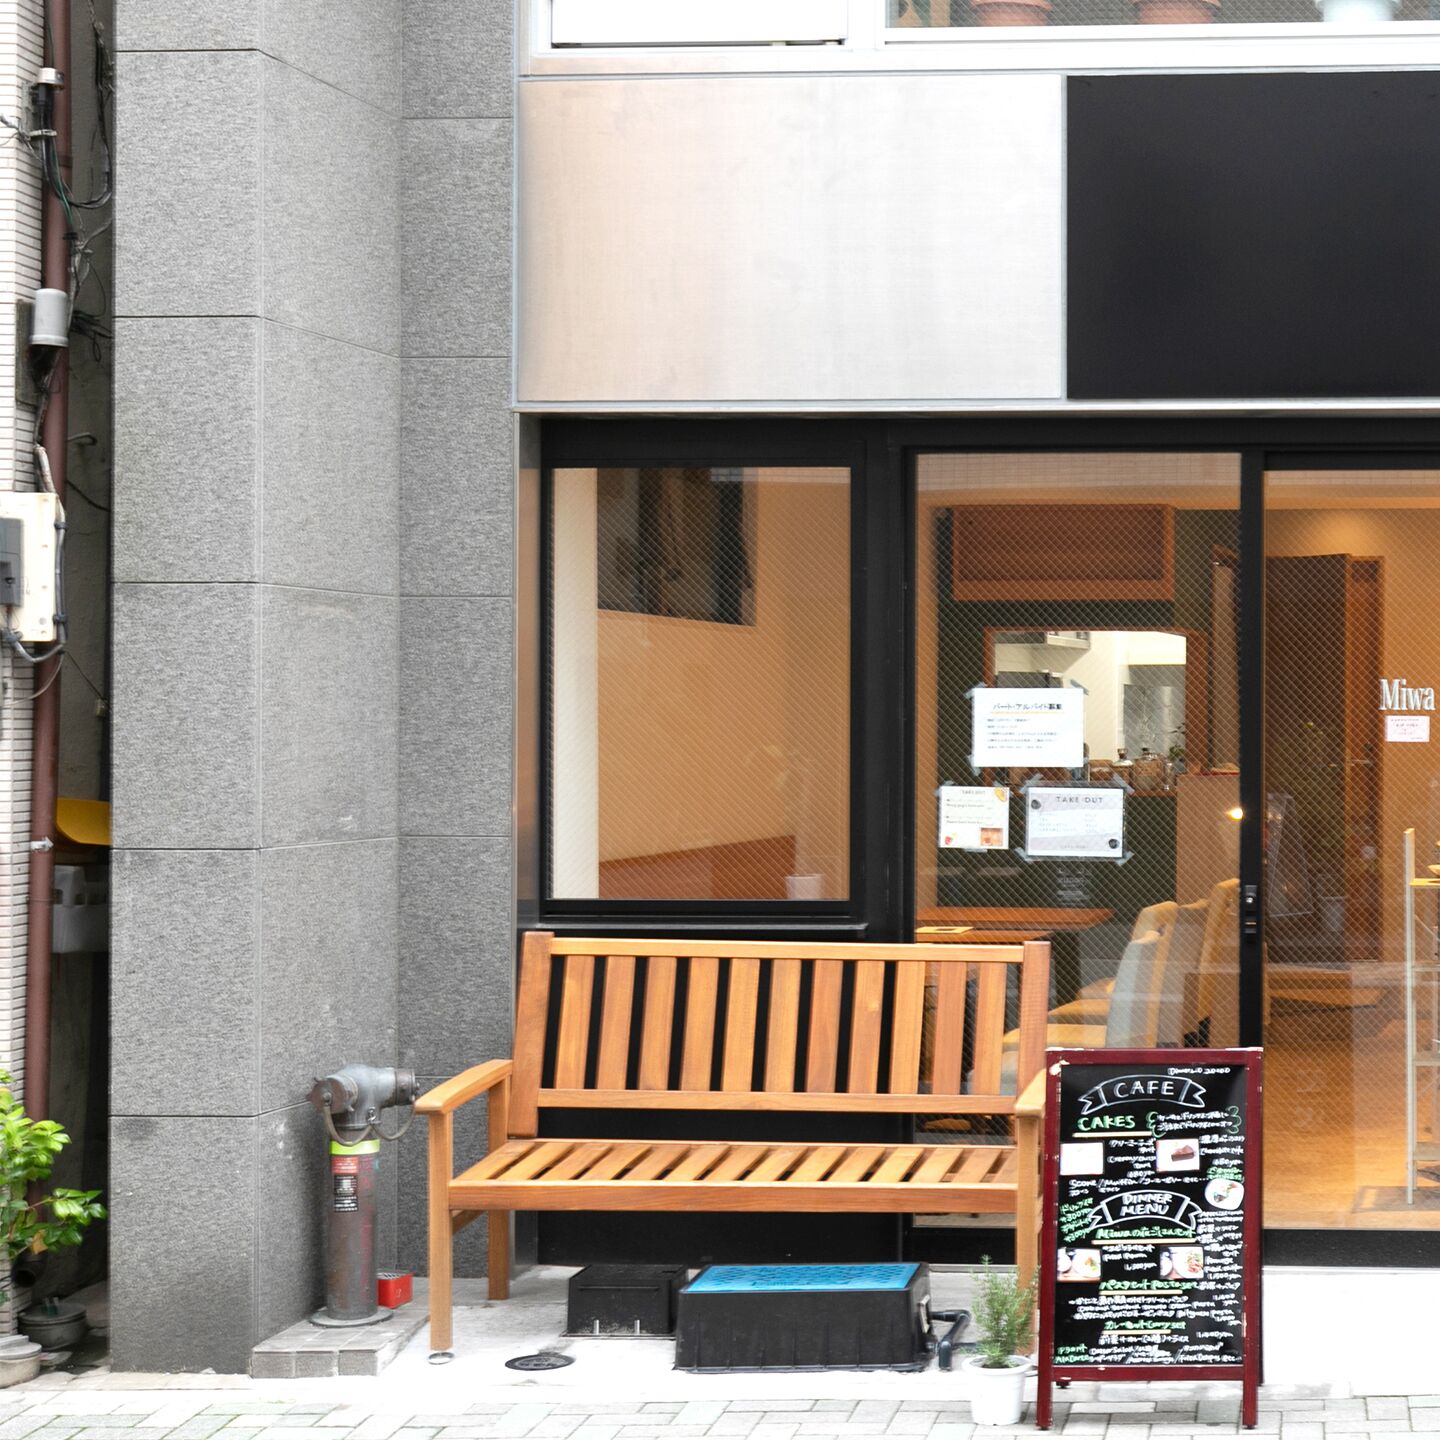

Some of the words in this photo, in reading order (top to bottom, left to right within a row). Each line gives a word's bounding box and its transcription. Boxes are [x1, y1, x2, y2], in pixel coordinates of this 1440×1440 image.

[1378, 678, 1436, 711] Miwa
[1056, 796, 1079, 804] TAKE
[1085, 796, 1104, 804] OUT
[1113, 1081, 1175, 1098] CAFE
[1077, 1114, 1136, 1132] CAKES
[1122, 1193, 1173, 1205] DINNER
[1120, 1204, 1170, 1216] MENU
